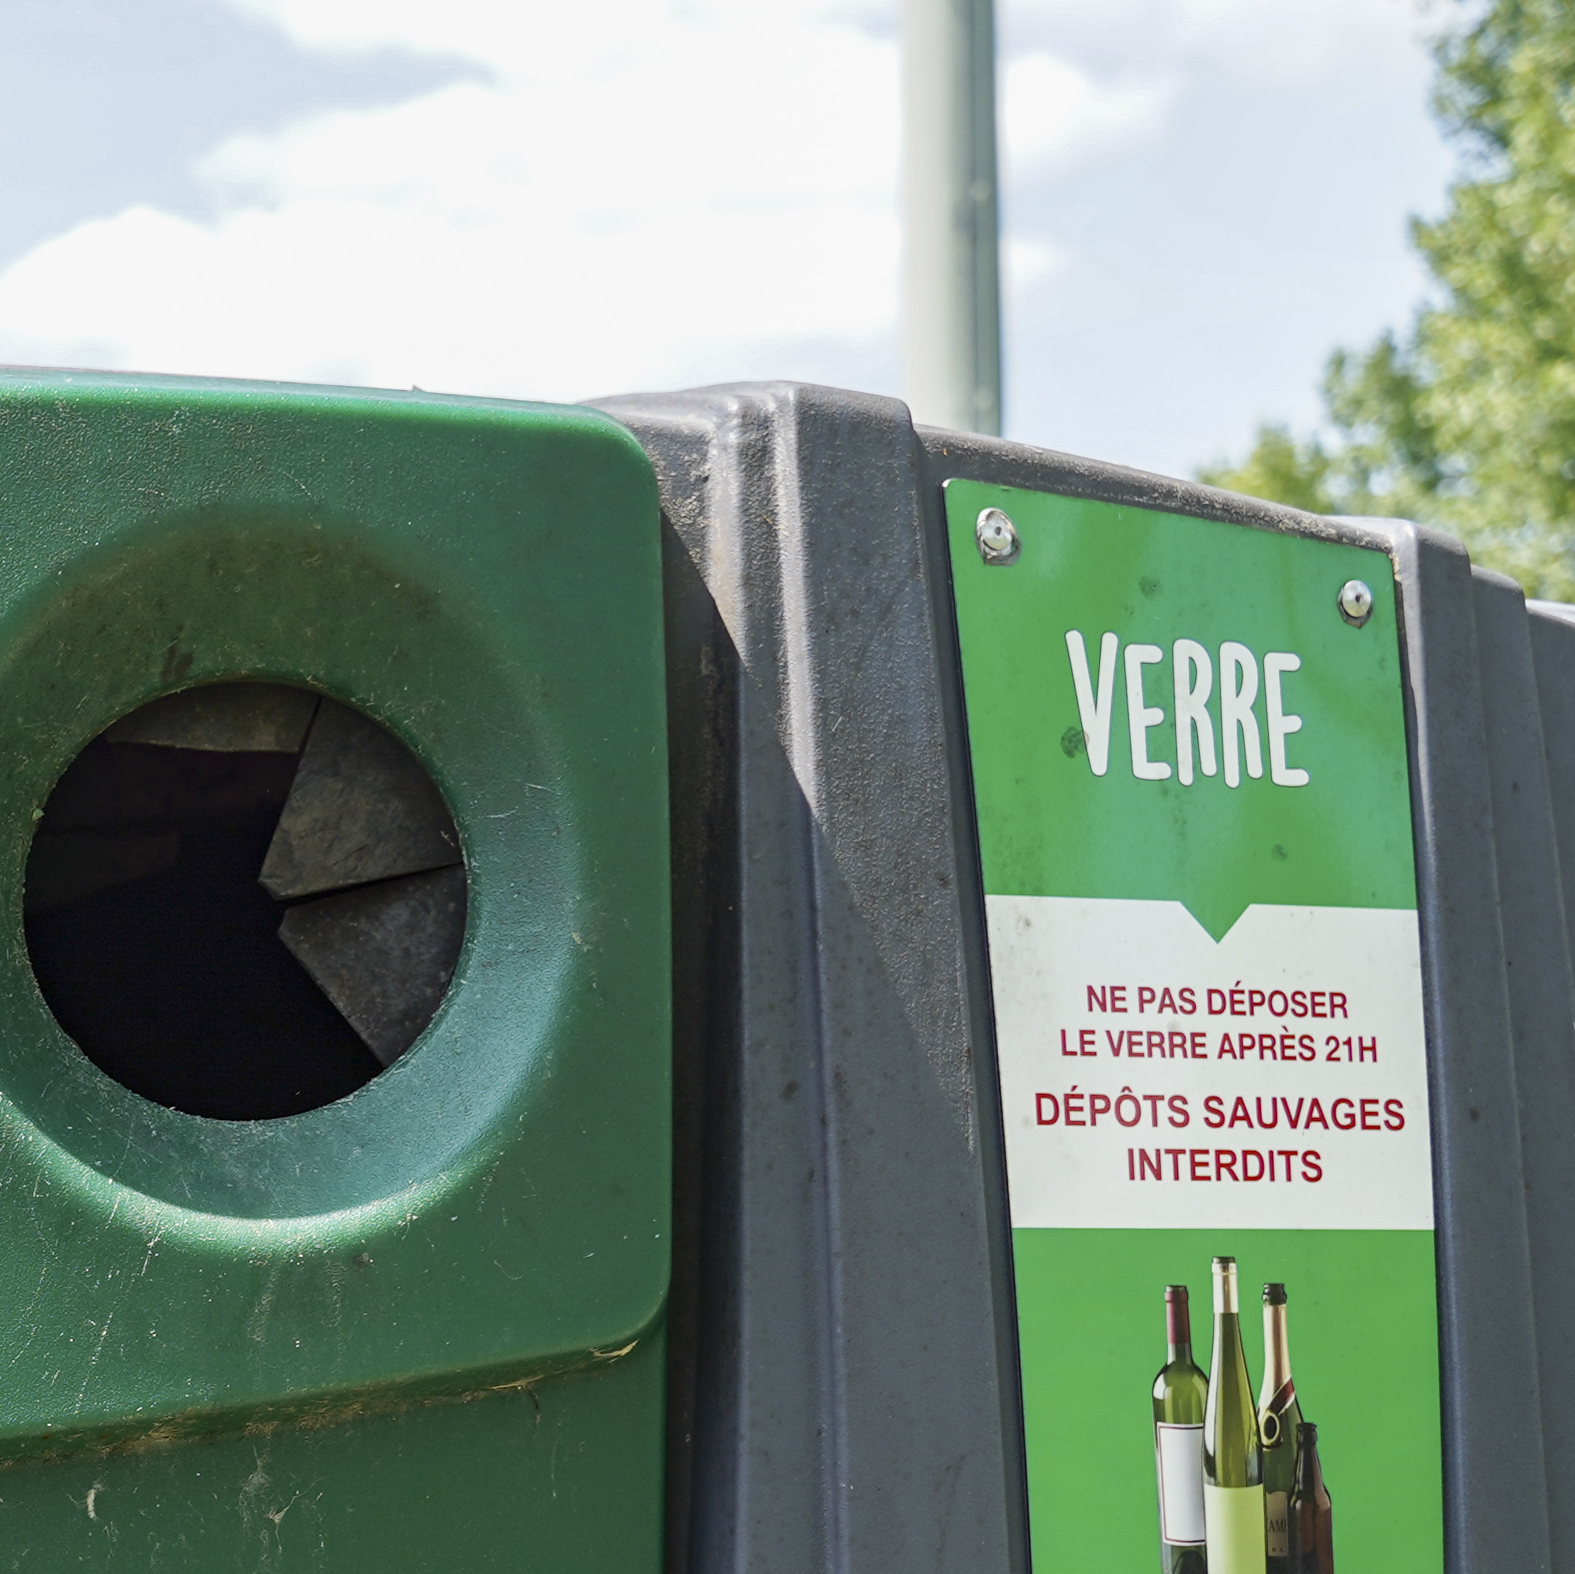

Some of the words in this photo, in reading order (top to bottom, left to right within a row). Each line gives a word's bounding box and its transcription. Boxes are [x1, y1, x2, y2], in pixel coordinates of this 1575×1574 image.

[1064, 628, 1311, 788] VERRE
[1085, 984, 1129, 1014] NE
[1137, 986, 1197, 1015] PAS
[1206, 980, 1349, 1020] DÉPOSER
[1059, 1028, 1098, 1057] LE
[1105, 1030, 1209, 1060] VERRE
[1217, 1026, 1317, 1063] APRÈS
[1325, 1035, 1379, 1063] 21H
[1034, 1086, 1191, 1129] DÉPÔTS
[1202, 1096, 1407, 1132] SAUVAGES
[1126, 1148, 1324, 1183] INTERDITS
